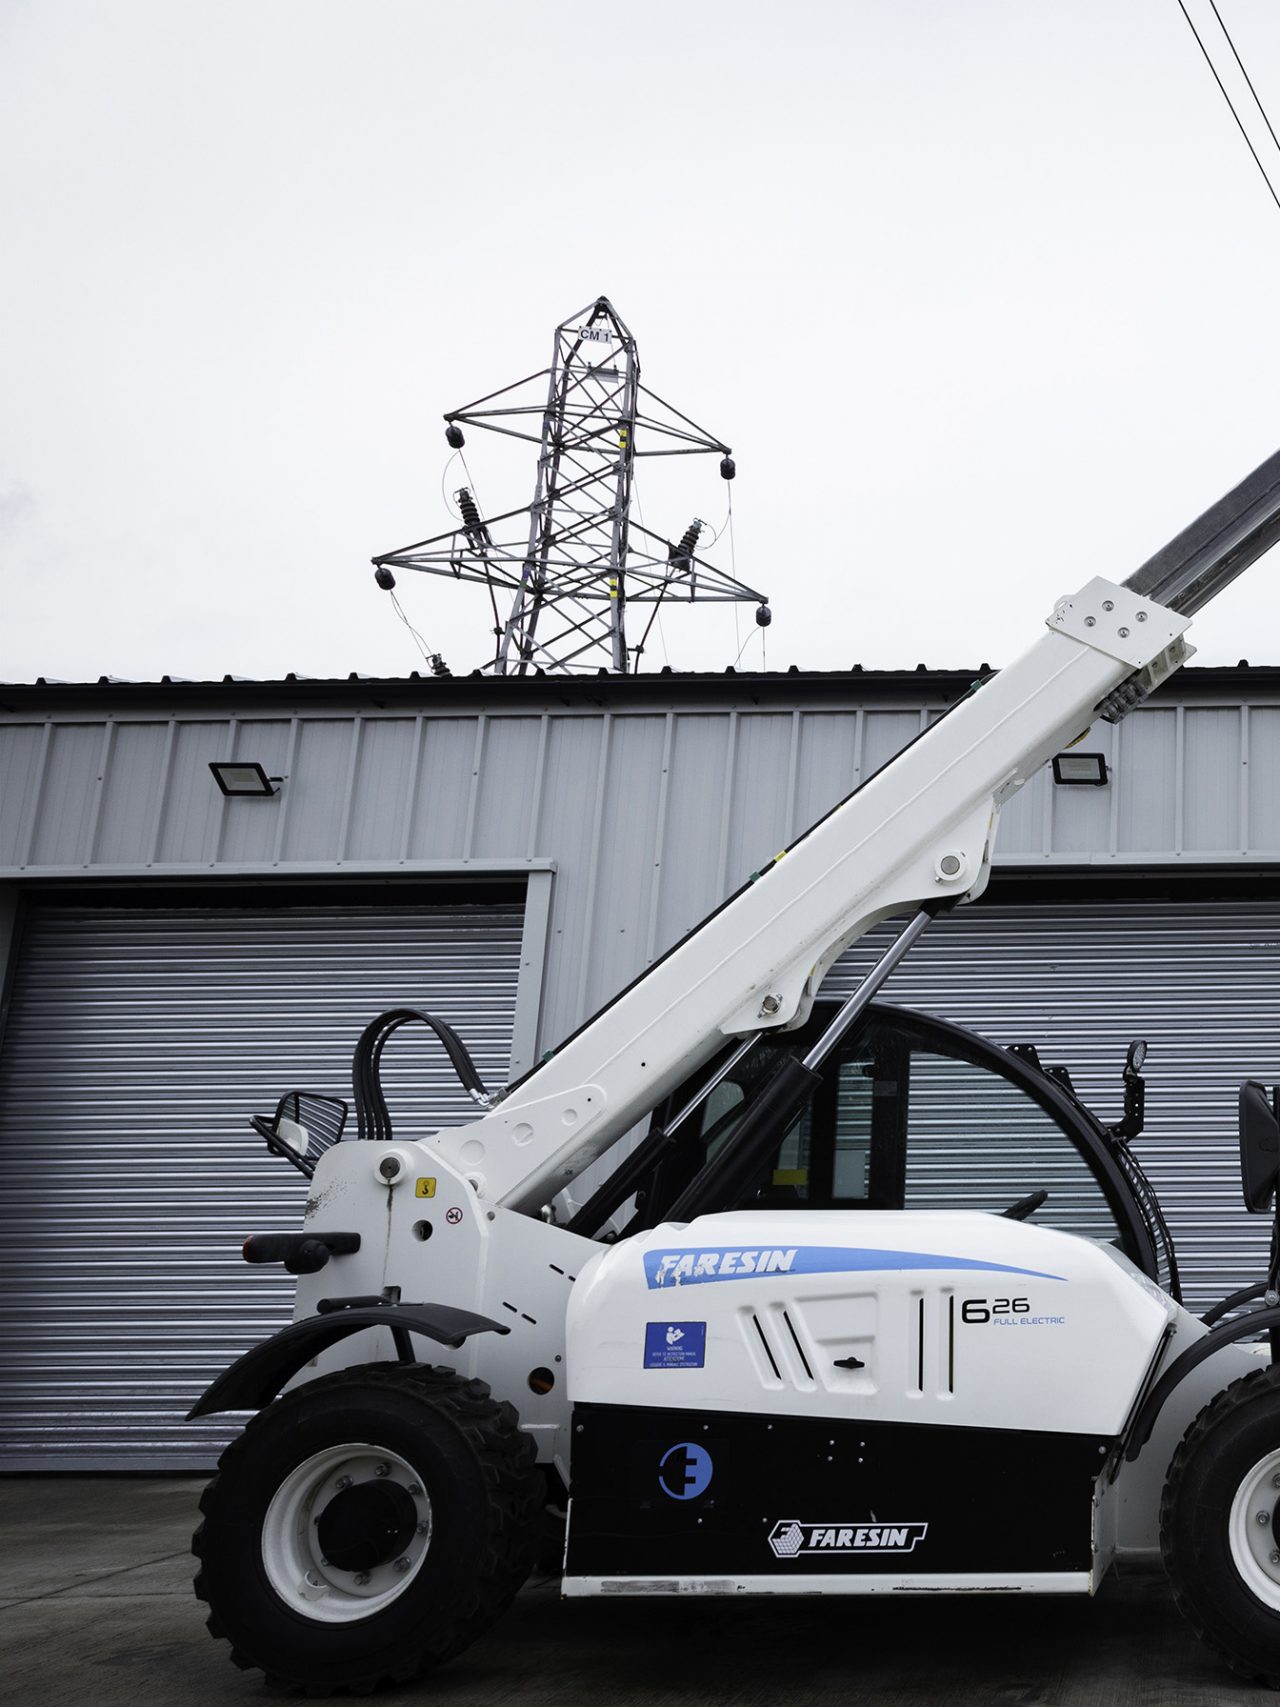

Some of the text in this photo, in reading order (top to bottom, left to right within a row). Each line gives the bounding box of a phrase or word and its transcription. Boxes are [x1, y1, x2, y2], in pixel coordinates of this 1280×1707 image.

[581, 329, 600, 341] CM
[656, 1249, 798, 1285] FARESIN
[993, 1316, 1065, 1326] FULL ELECTRIC
[808, 1528, 909, 1547] FARESIN
